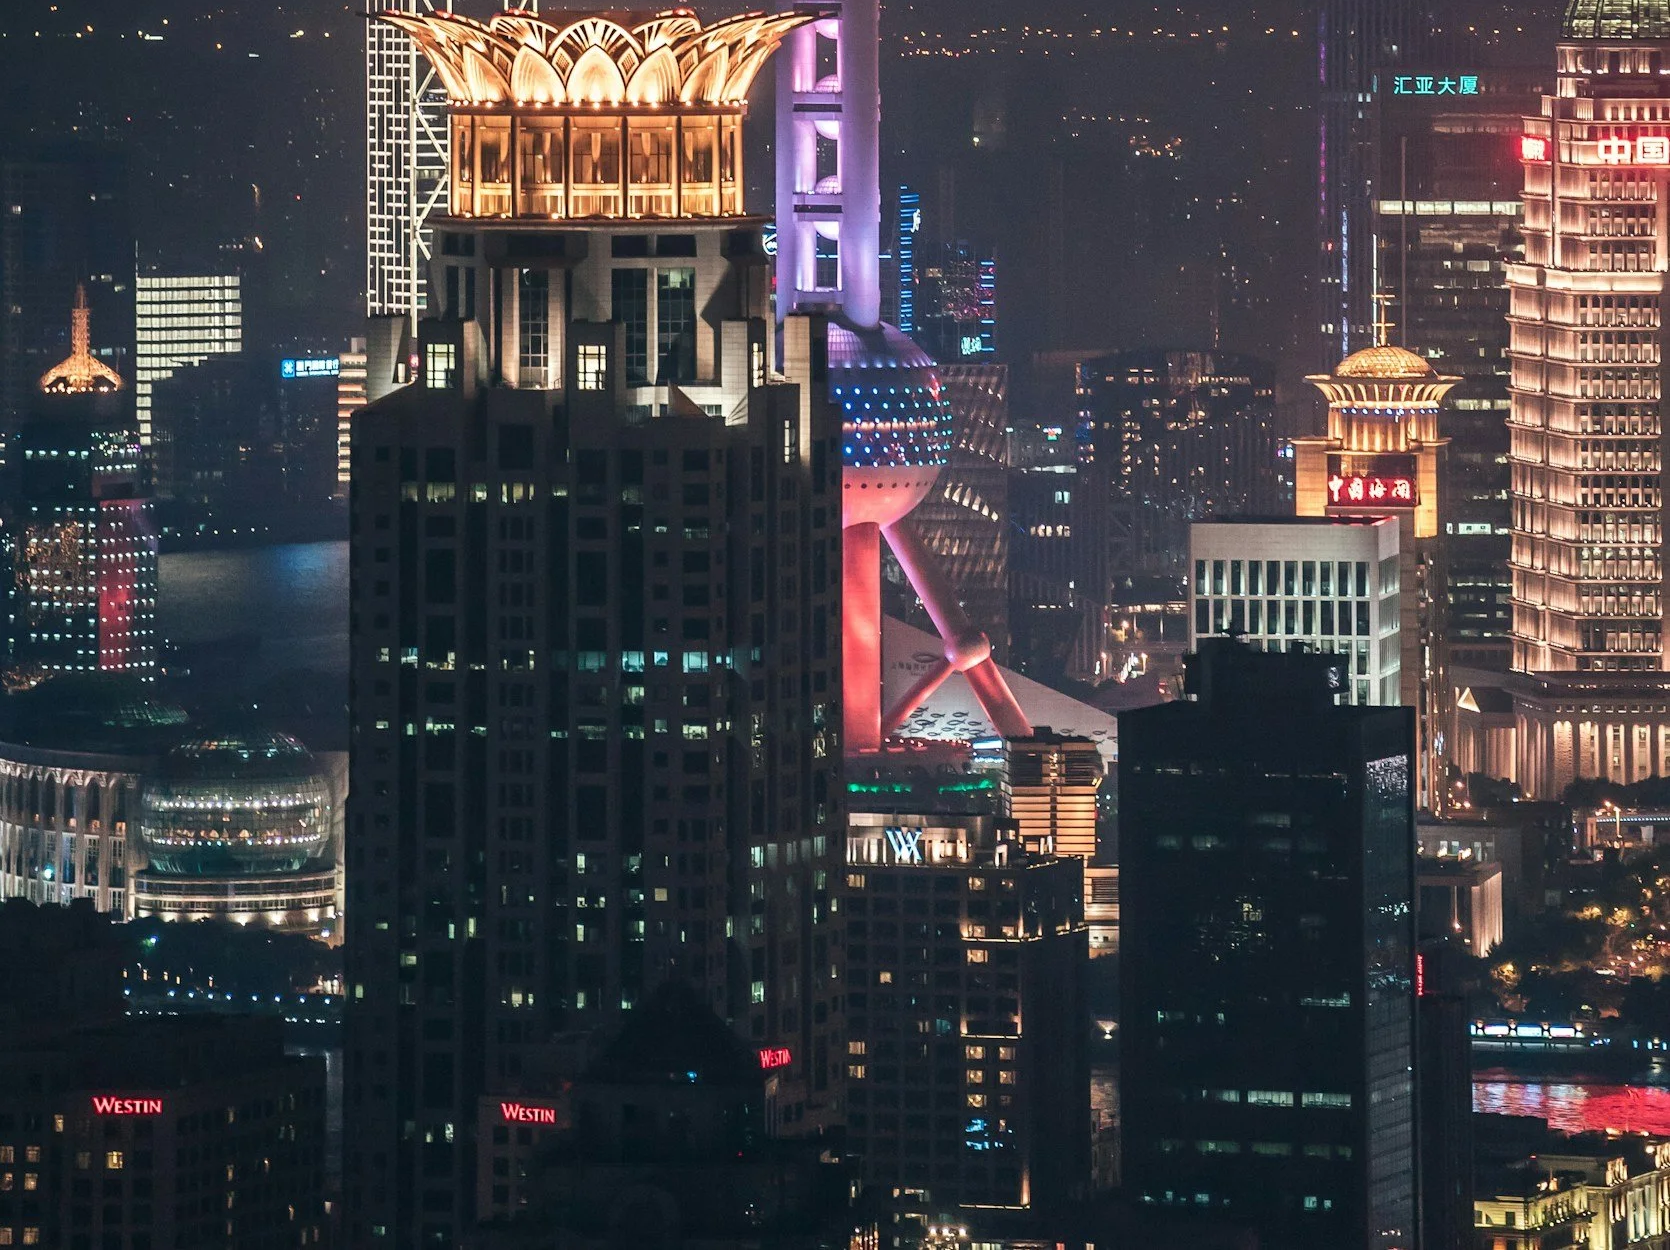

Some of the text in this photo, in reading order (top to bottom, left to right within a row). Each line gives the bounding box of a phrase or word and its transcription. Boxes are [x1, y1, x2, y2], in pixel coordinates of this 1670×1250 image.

[1394, 75, 1478, 95] 汇亚大厦
[1598, 136, 1670, 165] 中国
[760, 1049, 791, 1068] WESTIN
[93, 1096, 163, 1114] WESTIN
[501, 1103, 555, 1123] WESTIN
